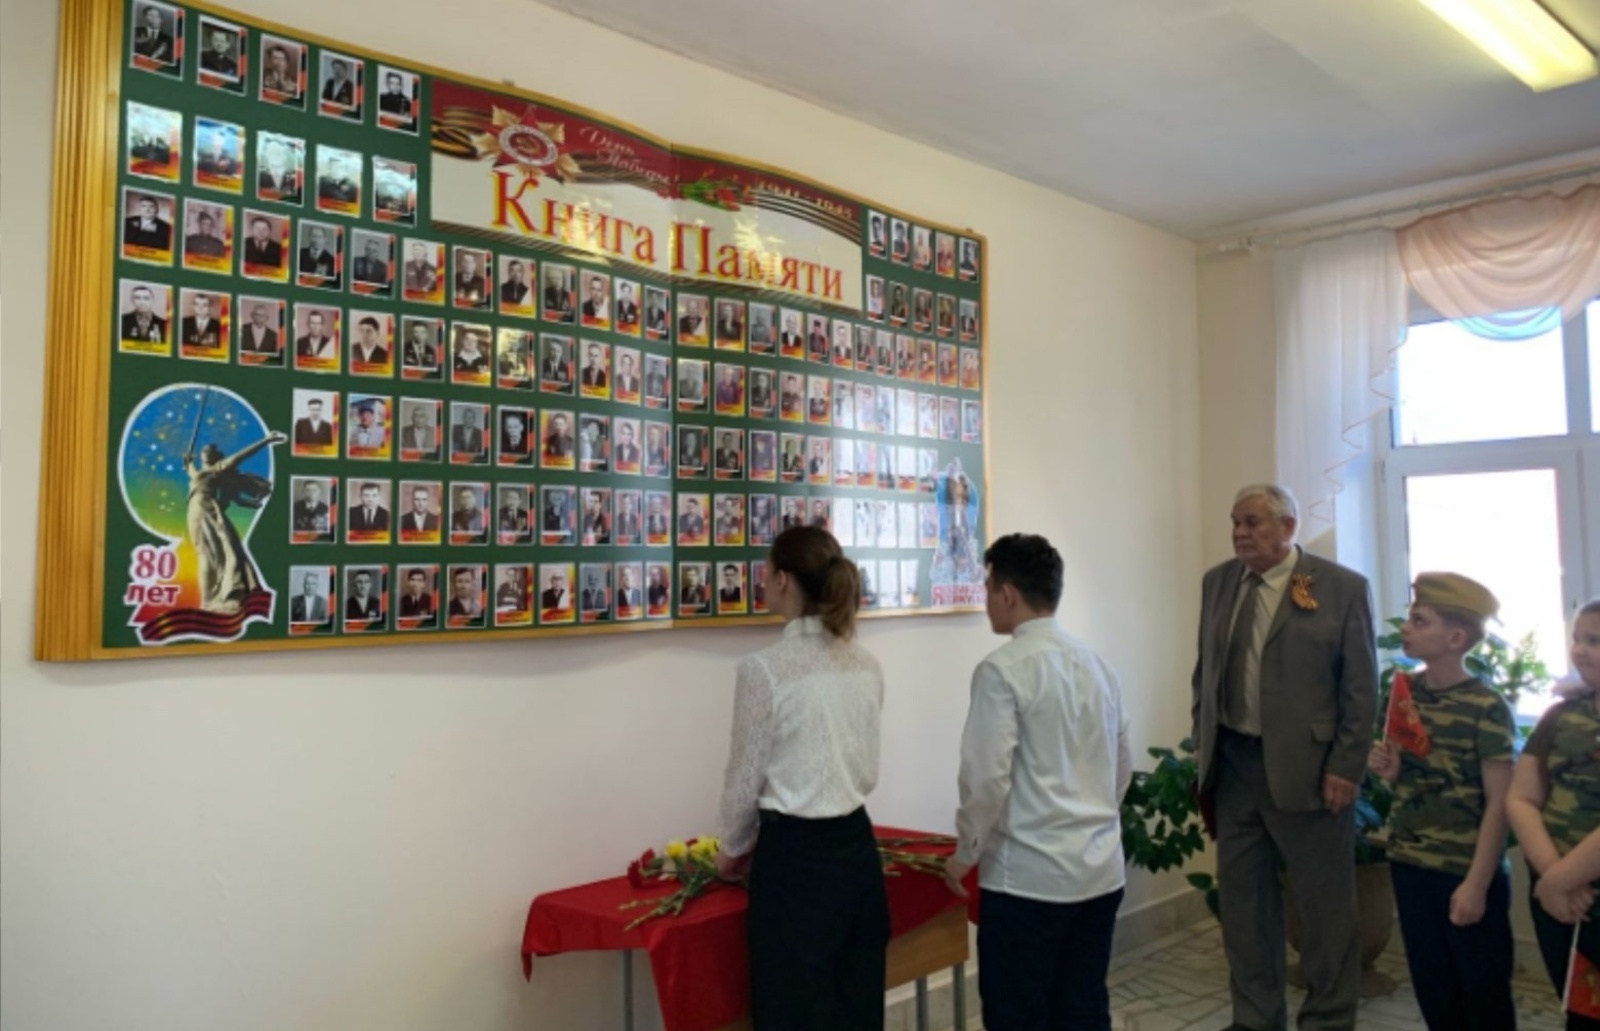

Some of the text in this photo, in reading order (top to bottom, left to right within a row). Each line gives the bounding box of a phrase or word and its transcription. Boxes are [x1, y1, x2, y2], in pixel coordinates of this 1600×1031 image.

[490, 169, 843, 301] Книга Памяти
[135, 549, 177, 579] 80
[127, 584, 178, 604] лет
